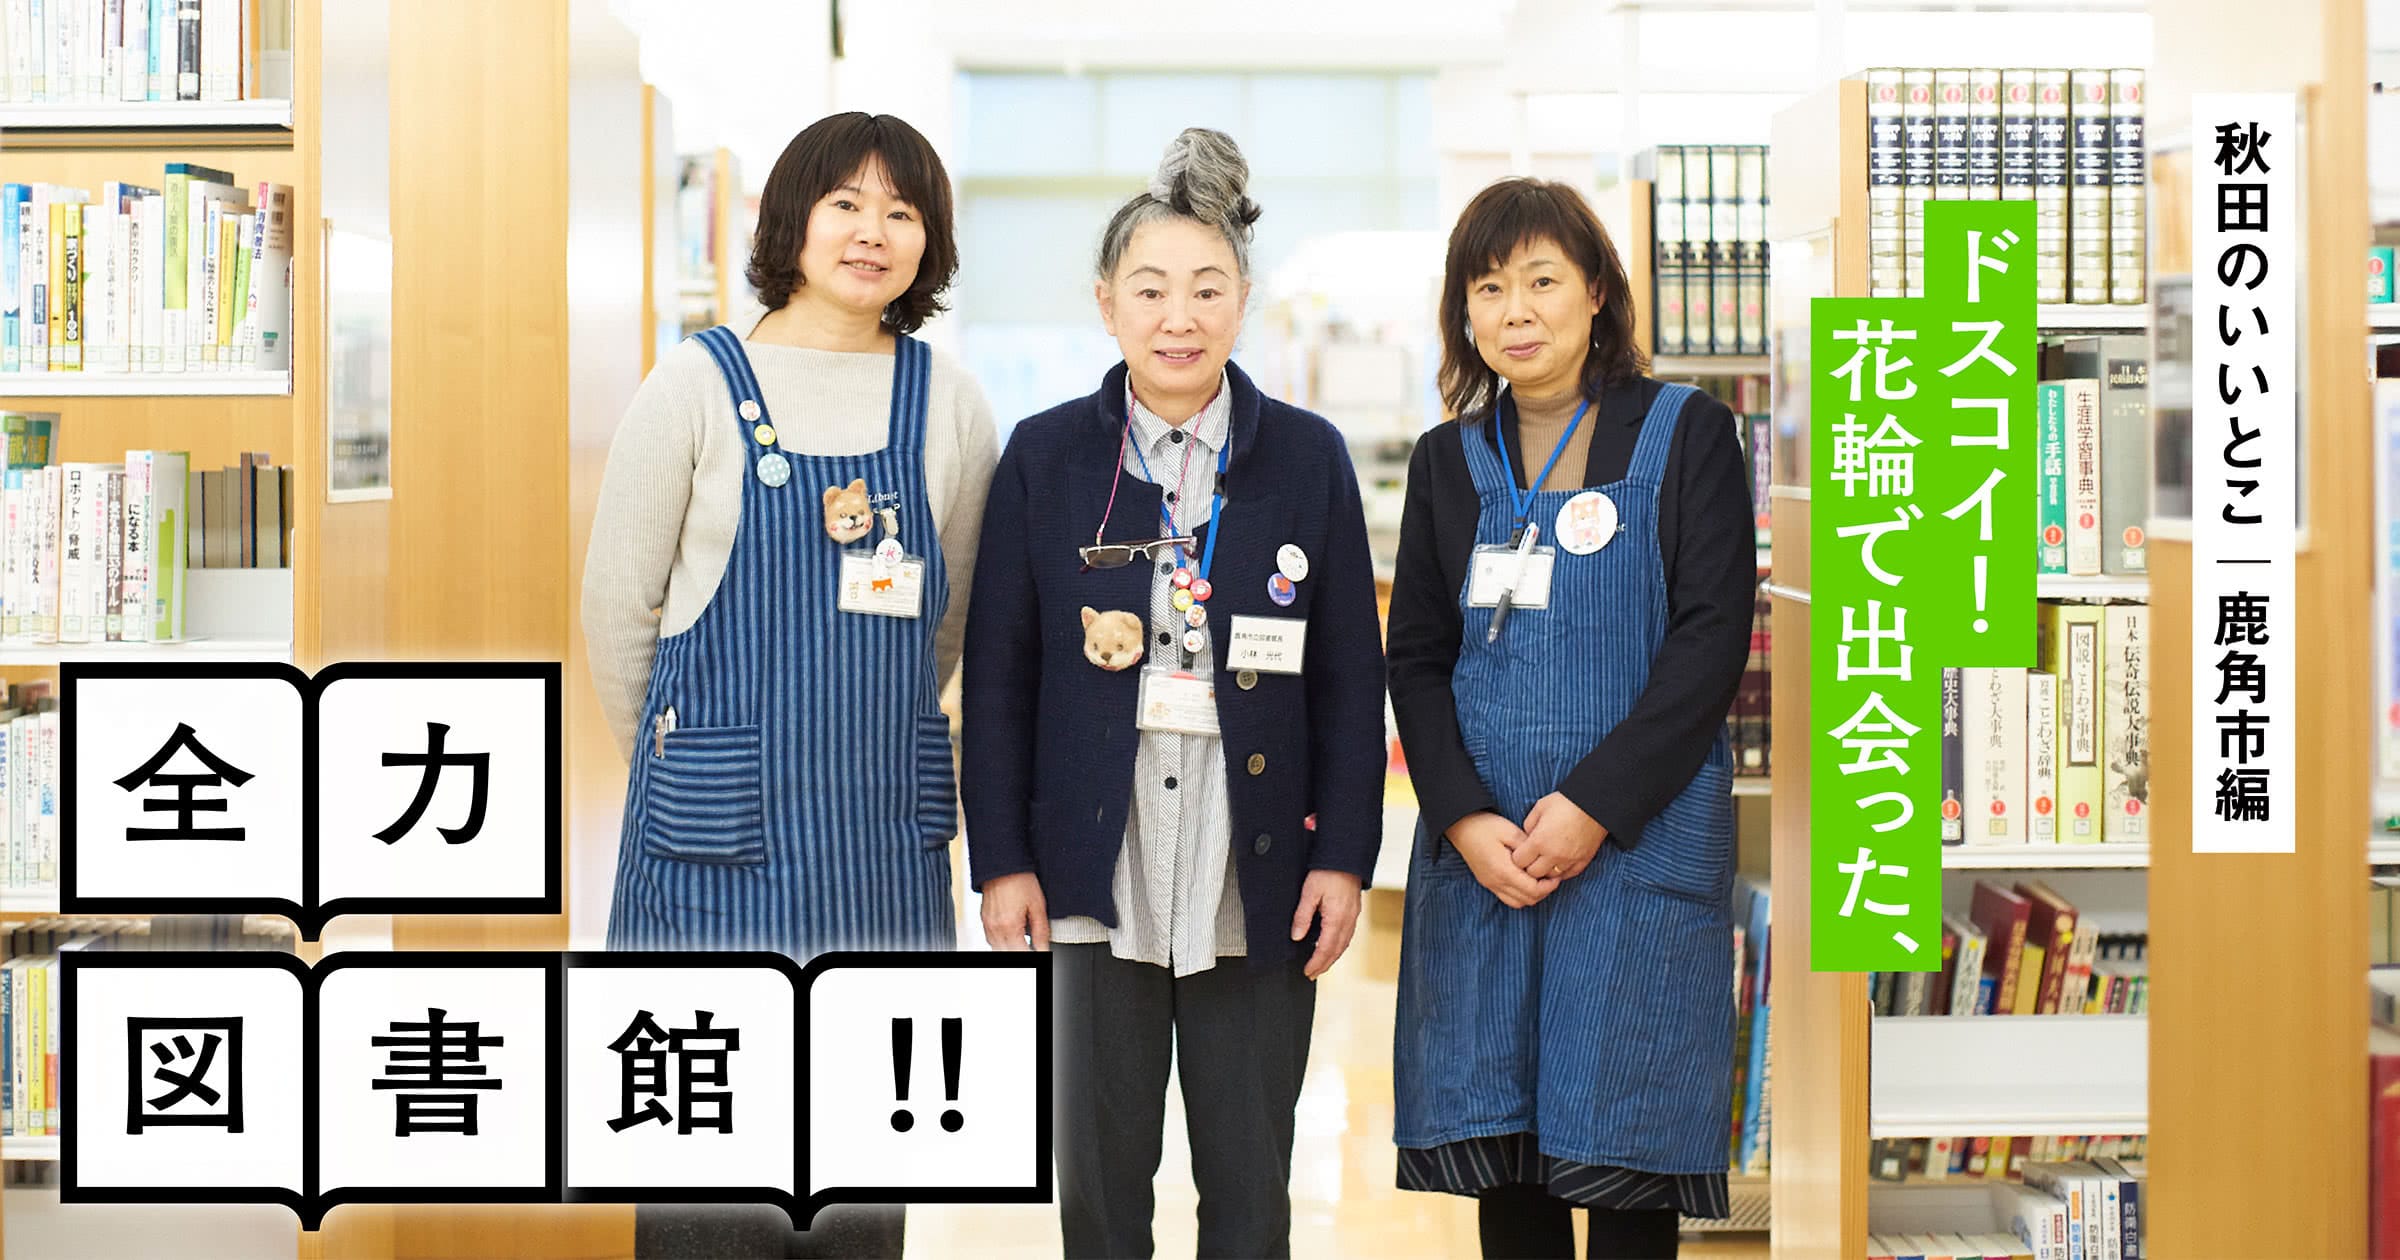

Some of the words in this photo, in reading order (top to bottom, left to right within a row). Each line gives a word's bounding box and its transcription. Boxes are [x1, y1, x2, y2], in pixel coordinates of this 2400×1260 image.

[2076, 391, 2095, 495] 生涯学習事典
[67, 470, 82, 561] ロボットの脅威
